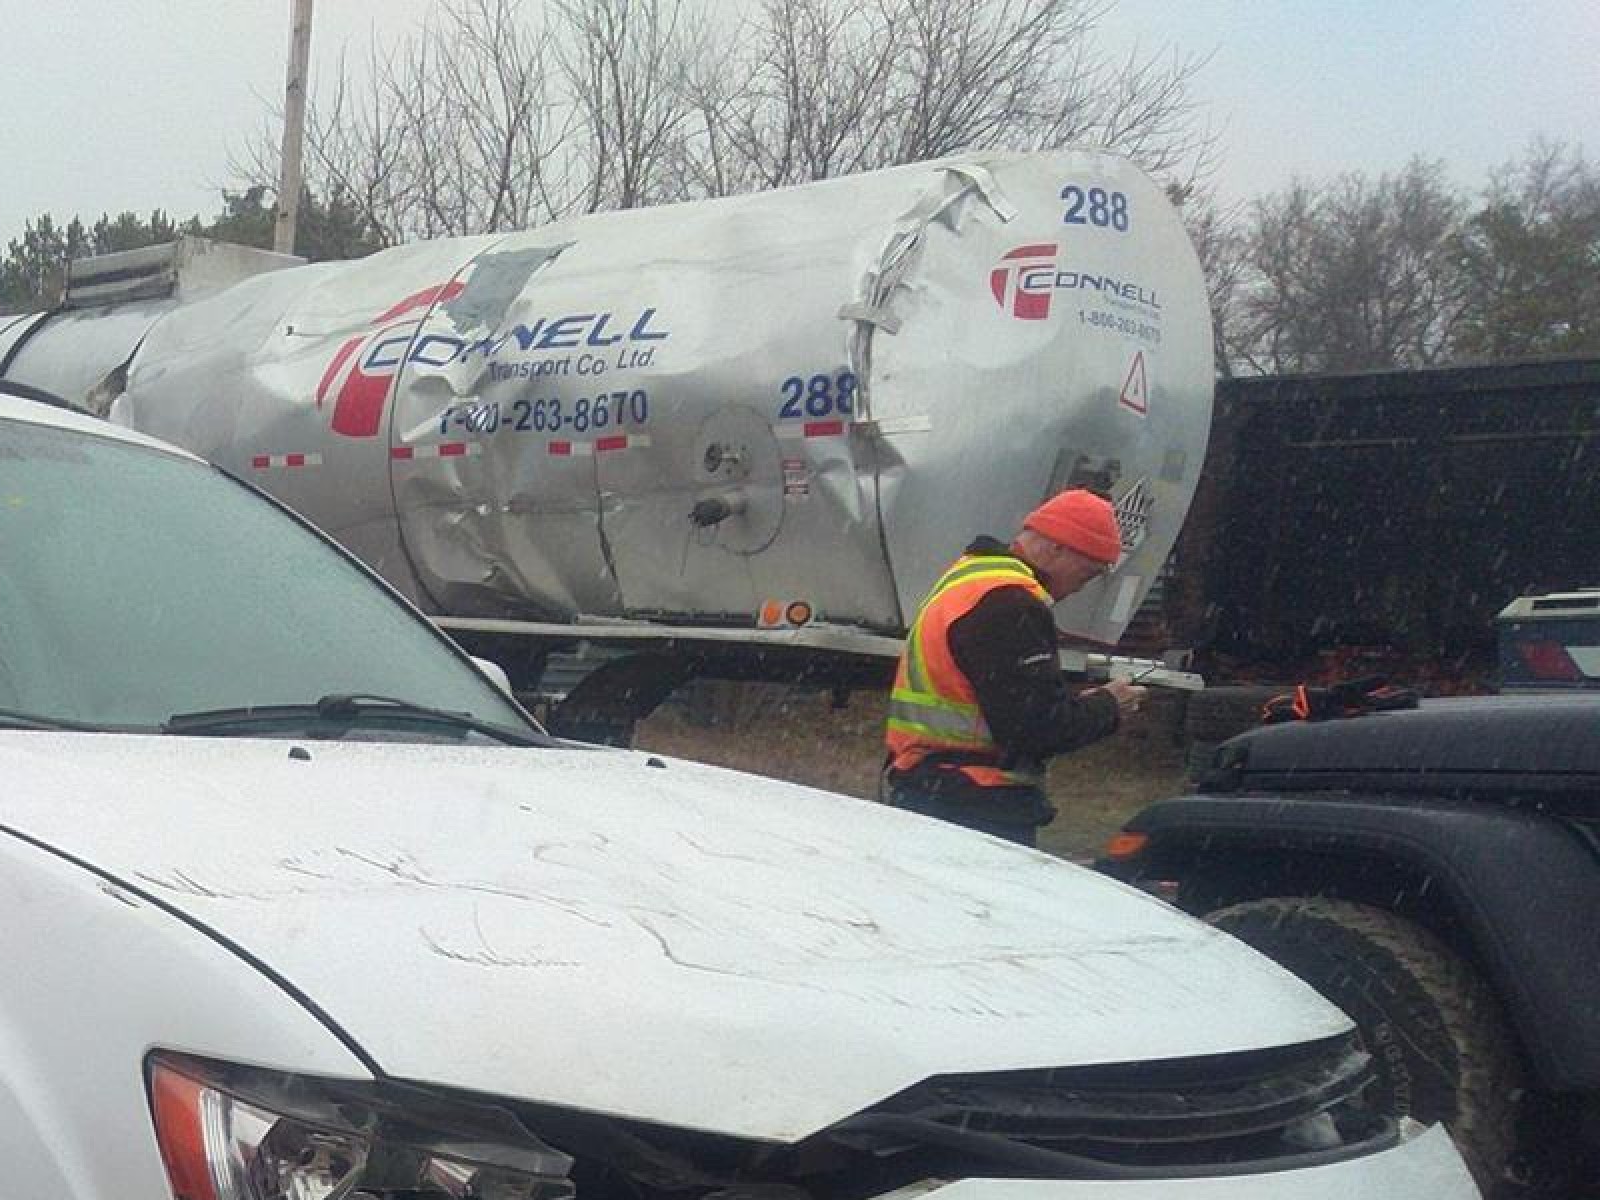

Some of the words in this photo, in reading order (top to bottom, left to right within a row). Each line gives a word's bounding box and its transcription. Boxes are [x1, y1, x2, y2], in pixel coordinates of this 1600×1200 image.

[1060, 185, 1128, 232] 288
[1023, 271, 1162, 309] CONNELL
[779, 372, 859, 419] 288
